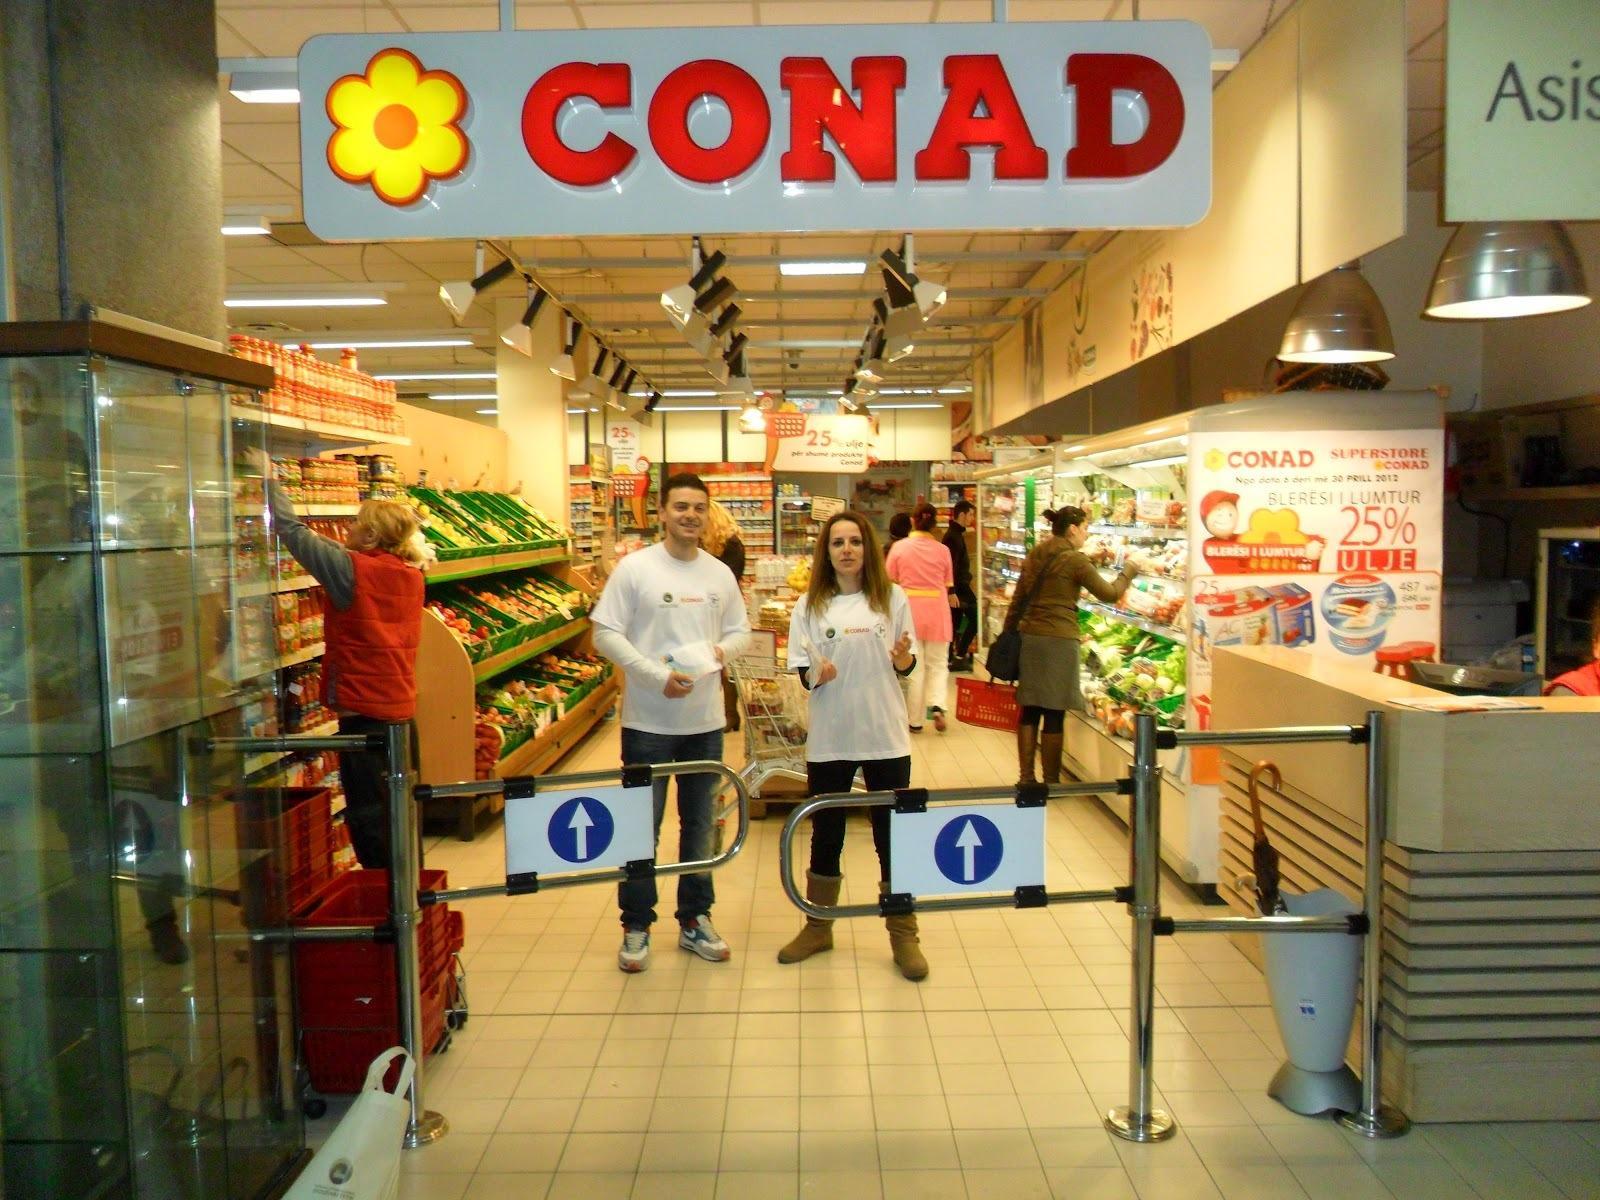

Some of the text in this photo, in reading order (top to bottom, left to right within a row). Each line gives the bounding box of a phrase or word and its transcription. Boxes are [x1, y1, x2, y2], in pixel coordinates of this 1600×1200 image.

[521, 52, 1186, 187] CONAD
[1227, 450, 1315, 468] CONAD
[1331, 447, 1430, 459] SUPERSTORE
[1384, 460, 1430, 470] CONAD
[1331, 474, 1344, 483] 30
[1346, 474, 1372, 483] PRILL
[1375, 473, 1400, 483] 2012
[1351, 490, 1422, 505] LUMTUR
[1339, 506, 1417, 546] 25%
[1341, 550, 1413, 572] ULJE
